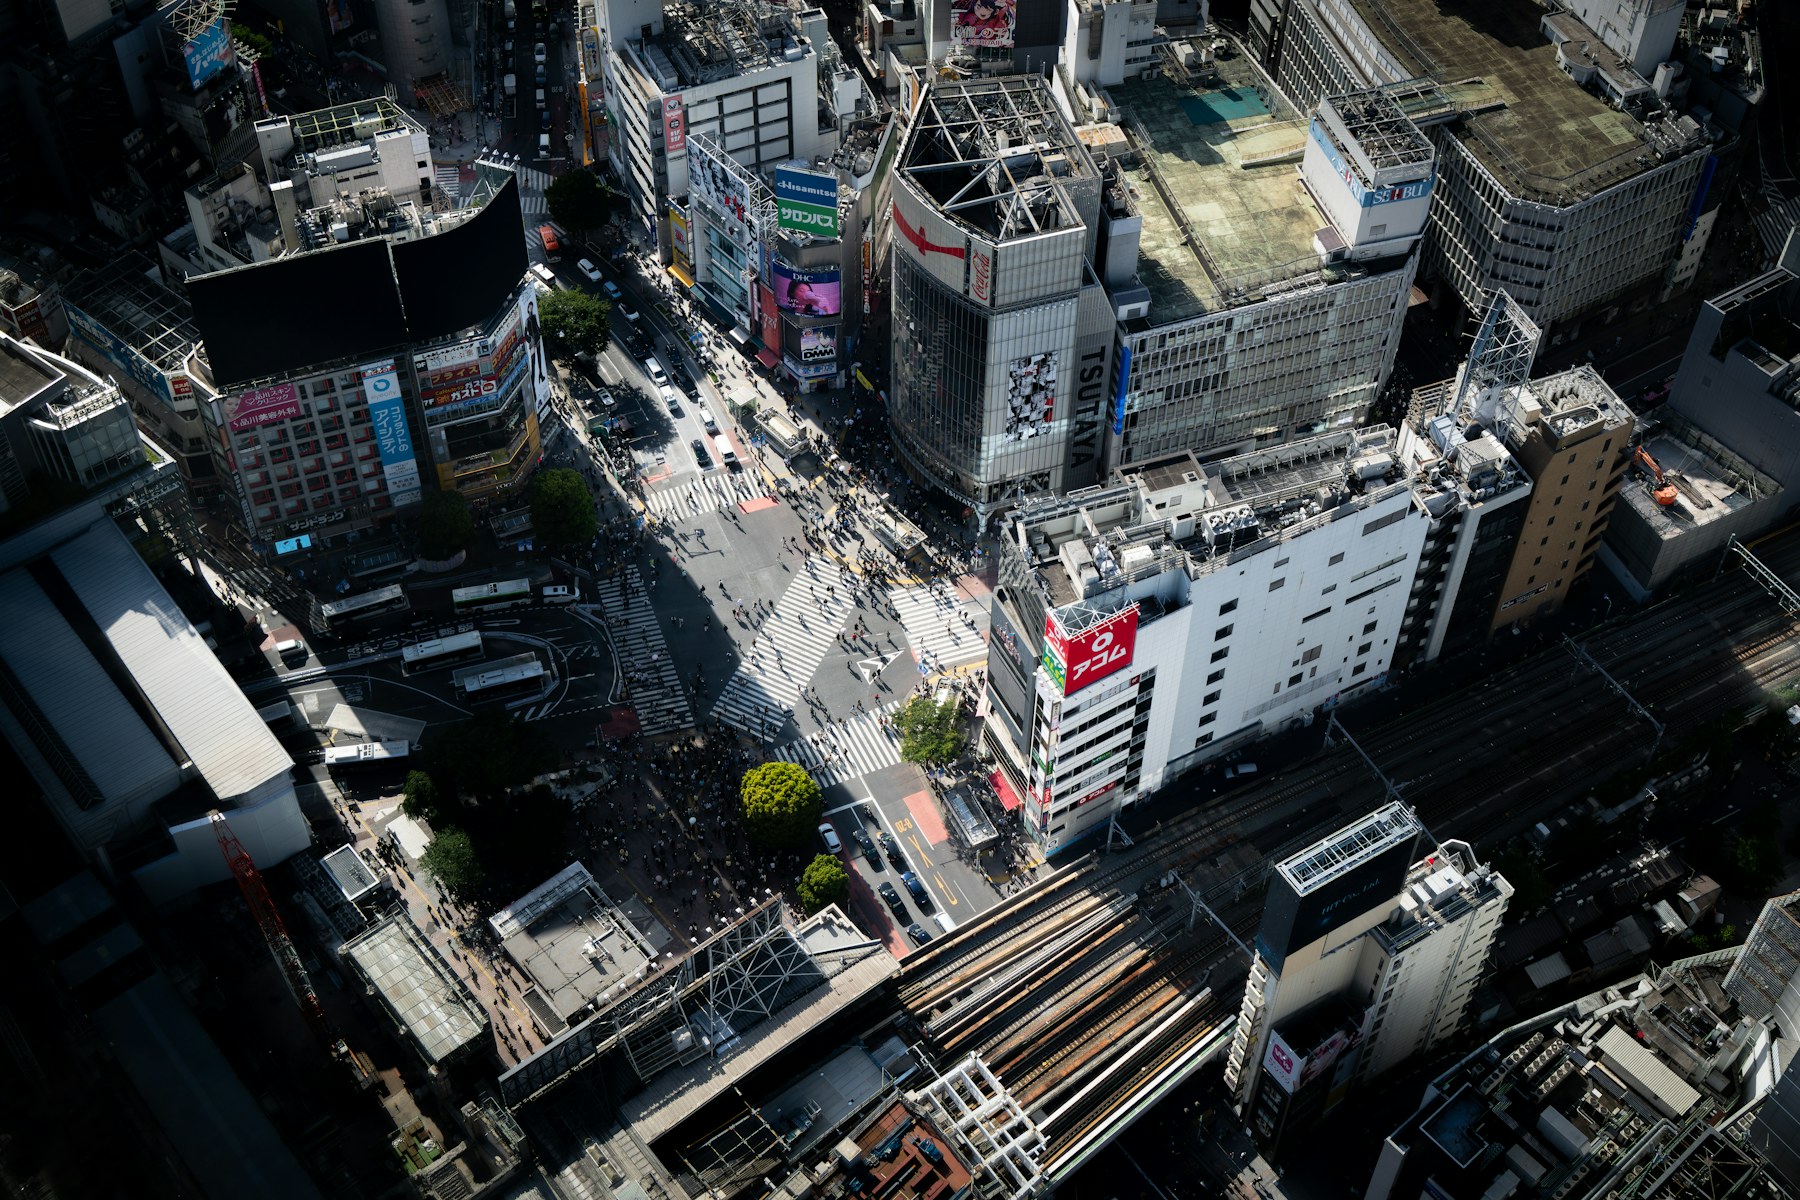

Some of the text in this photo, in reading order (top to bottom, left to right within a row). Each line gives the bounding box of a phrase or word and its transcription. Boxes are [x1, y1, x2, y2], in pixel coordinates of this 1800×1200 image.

[777, 180, 836, 198] Hisamitsu
[1373, 184, 1424, 204] SEIBU
[781, 207, 834, 229] サロンパス
[792, 272, 814, 282] DHC
[972, 248, 990, 300] Coca-Cola
[803, 349, 834, 359] DMM
[257, 394, 288, 406] クリニック
[424, 398, 434, 407] 7F
[451, 388, 480, 401] ガスト
[240, 407, 297, 427] 品川美容外科
[1071, 346, 1106, 469] TSUTAYA
[374, 408, 398, 455] アイシティ
[290, 510, 345, 531] サンドラッグ
[1073, 644, 1127, 681] アコム
